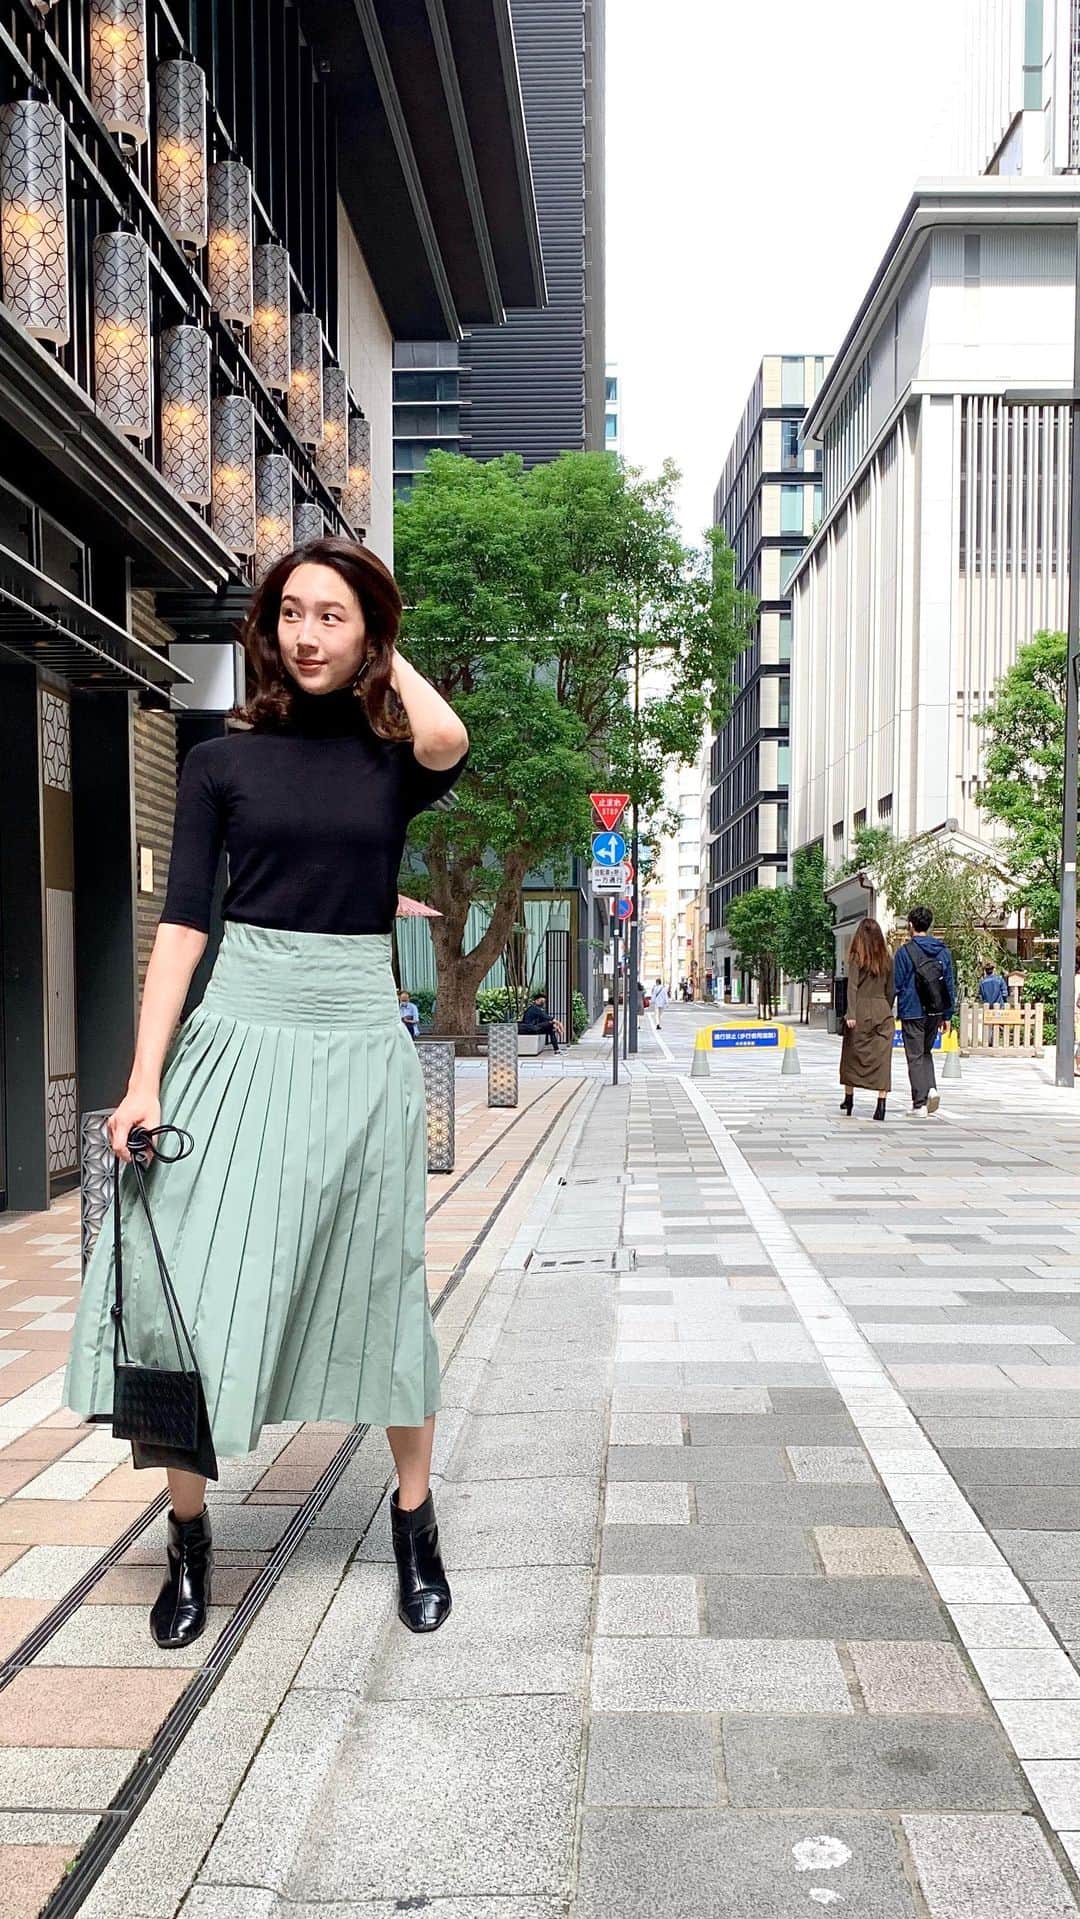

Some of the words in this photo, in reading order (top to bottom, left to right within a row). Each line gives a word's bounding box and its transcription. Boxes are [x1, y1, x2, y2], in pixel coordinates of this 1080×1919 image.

[598, 798, 622, 807] 止まれ
[602, 807, 619, 816] STOP
